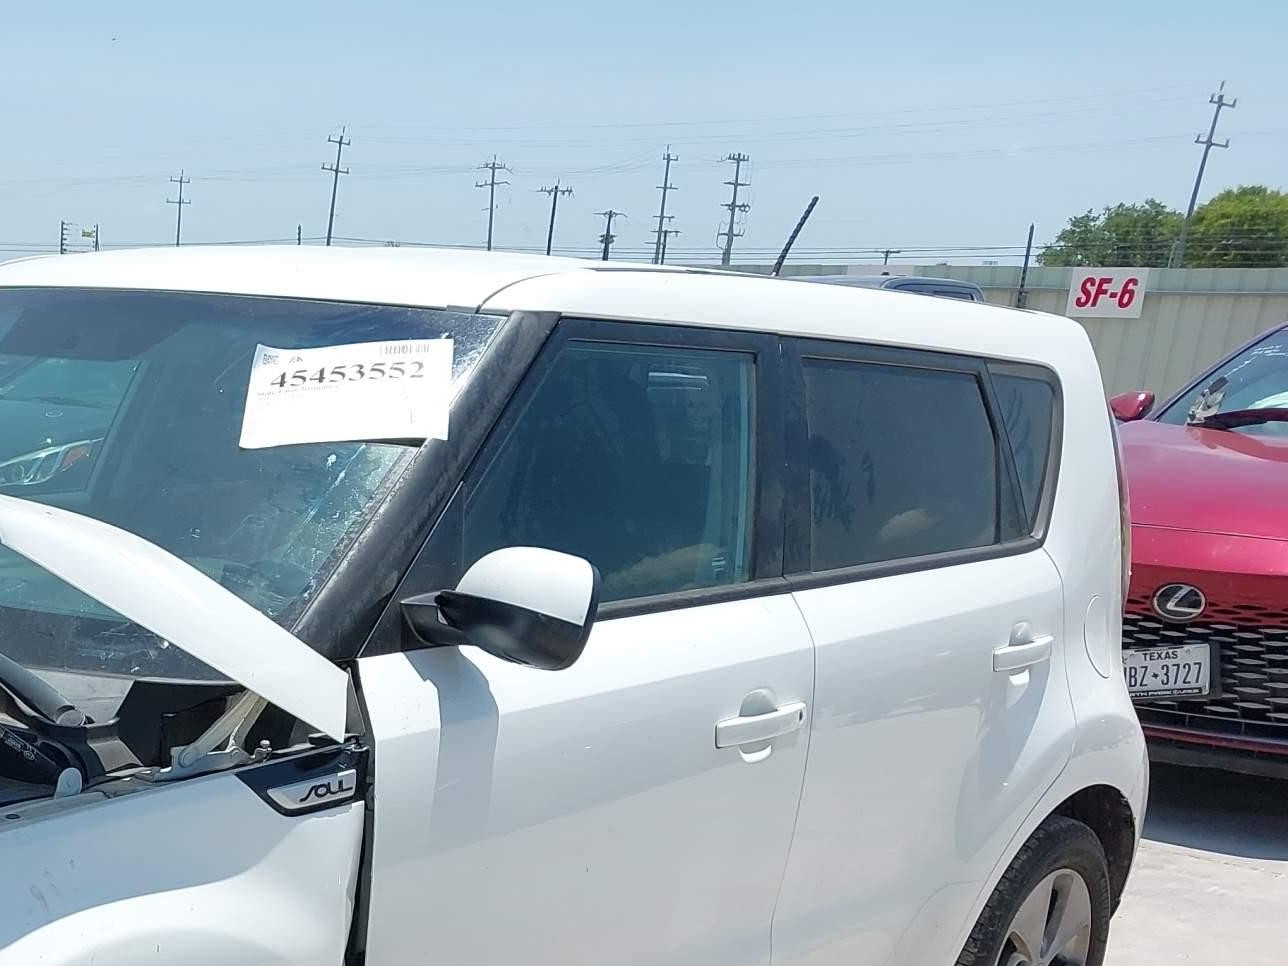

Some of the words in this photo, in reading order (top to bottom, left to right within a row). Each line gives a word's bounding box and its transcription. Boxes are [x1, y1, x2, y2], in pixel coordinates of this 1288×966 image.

[1075, 276, 1139, 309] SF-6
[270, 361, 425, 388] 45453552
[1142, 650, 1179, 661] TEXAS
